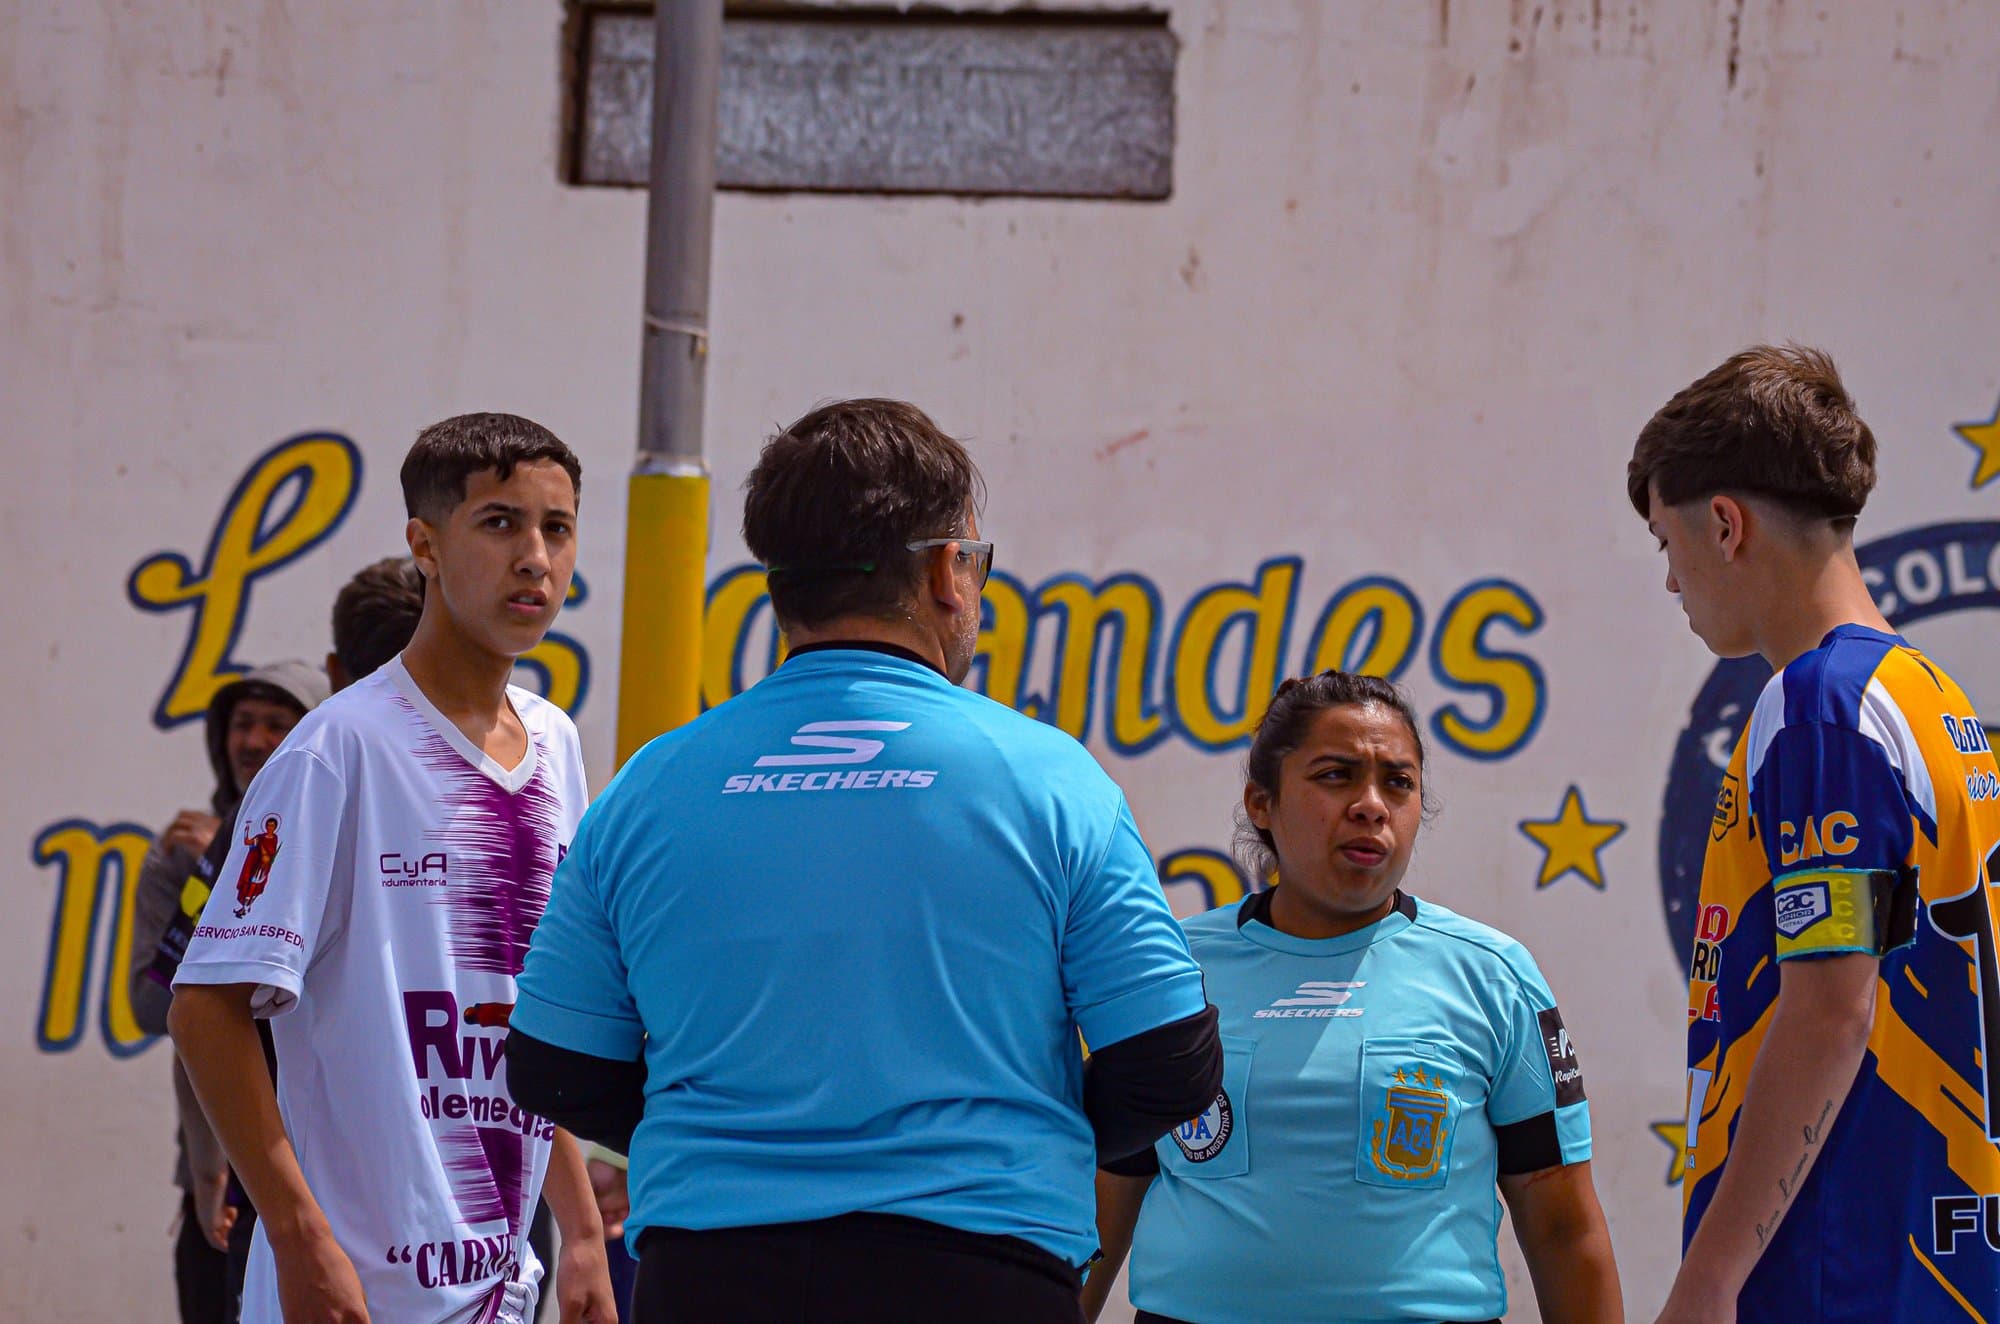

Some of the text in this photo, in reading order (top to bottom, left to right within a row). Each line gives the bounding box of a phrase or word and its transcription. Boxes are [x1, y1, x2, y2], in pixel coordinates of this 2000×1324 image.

[721, 769, 939, 795] SKECHERS
[1780, 810, 1860, 867] CAC
[240, 924, 258, 938] SAN
[1252, 1007, 1367, 1019] SKECHERS
[1194, 1151, 1205, 1160] DE
[1206, 1110, 1230, 1158] ARGENTINA
